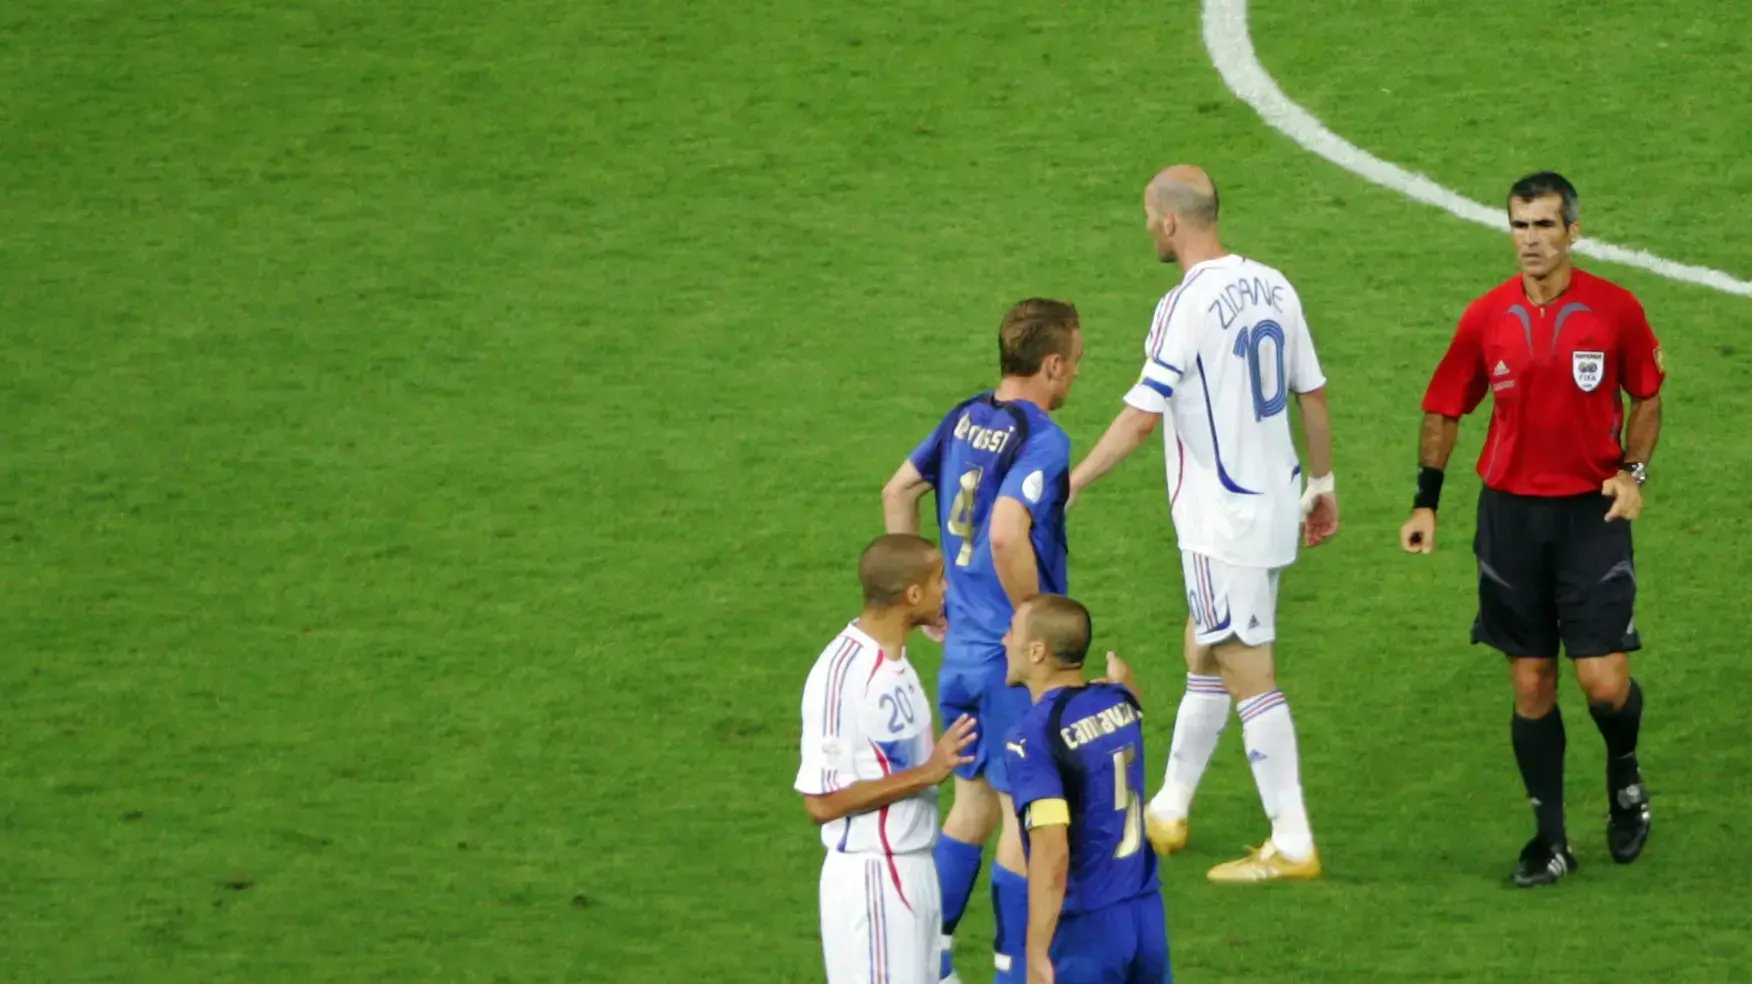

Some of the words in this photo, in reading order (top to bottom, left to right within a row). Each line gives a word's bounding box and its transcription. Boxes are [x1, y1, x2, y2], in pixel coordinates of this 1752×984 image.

[1208, 276, 1284, 330] ZIDANE
[1232, 318, 1287, 423] 10
[947, 461, 984, 567] 4
[879, 685, 915, 734] 20
[1107, 742, 1142, 859] 5
